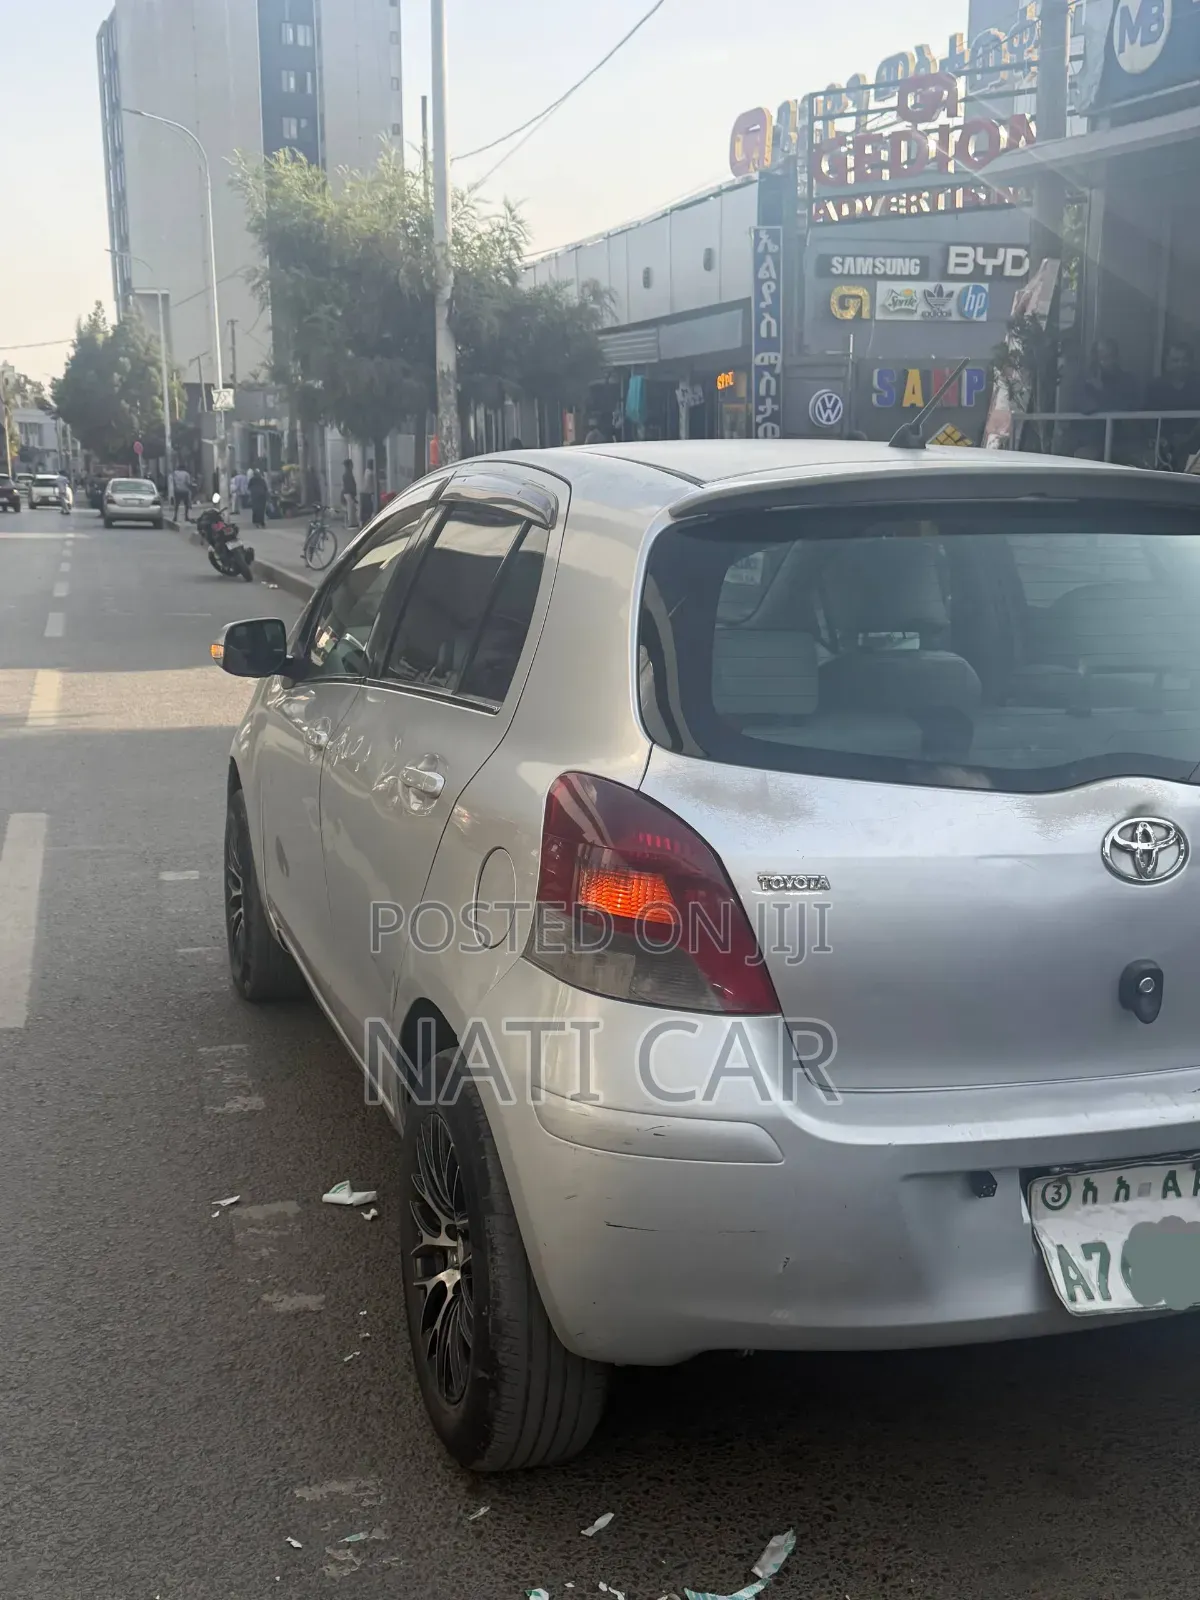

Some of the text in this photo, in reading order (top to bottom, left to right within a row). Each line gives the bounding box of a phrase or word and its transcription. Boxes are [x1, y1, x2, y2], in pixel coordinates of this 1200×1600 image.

[830, 256, 920, 276] SAMSUNG
[947, 245, 1030, 277] BYD
[888, 294, 919, 309] Sprite
[964, 287, 984, 319] hp
[757, 874, 831, 891] TOYOTA
